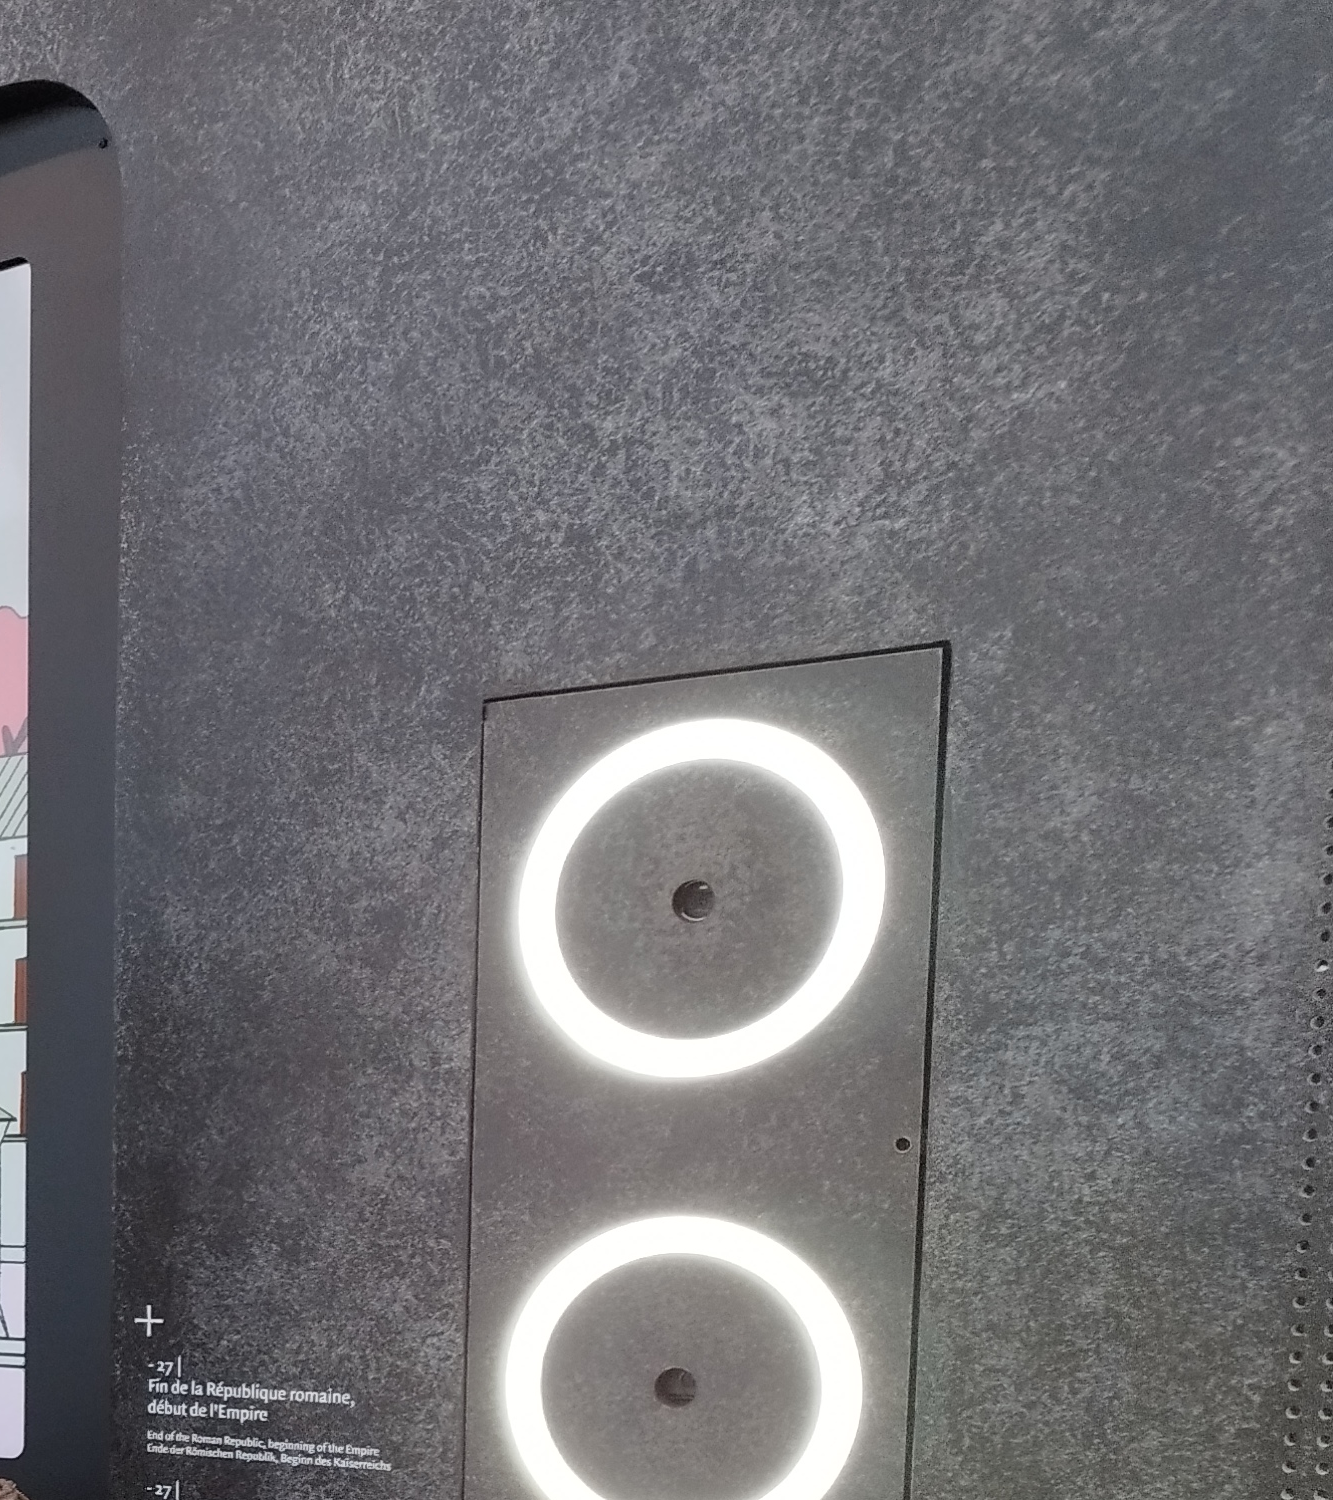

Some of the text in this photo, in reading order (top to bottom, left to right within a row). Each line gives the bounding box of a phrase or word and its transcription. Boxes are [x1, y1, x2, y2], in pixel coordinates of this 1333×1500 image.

[148, 1378, 355, 1408] Fin de la République romaine,
[147, 1399, 269, 1425] début de l'Empire
[146, 1443, 169, 1454] Ende
[280, 1453, 313, 1467] Beginn
[314, 1456, 332, 1467] des
[333, 1457, 392, 1472] Kaiserreichs
[147, 1430, 164, 1441] End
[164, 1430, 176, 1442] of
[175, 1431, 190, 1442] the
[191, 1433, 223, 1445] Roman
[268, 1438, 316, 1454] beginning
[316, 1441, 329, 1453] of
[328, 1442, 344, 1454] the
[345, 1443, 380, 1457] Empire
